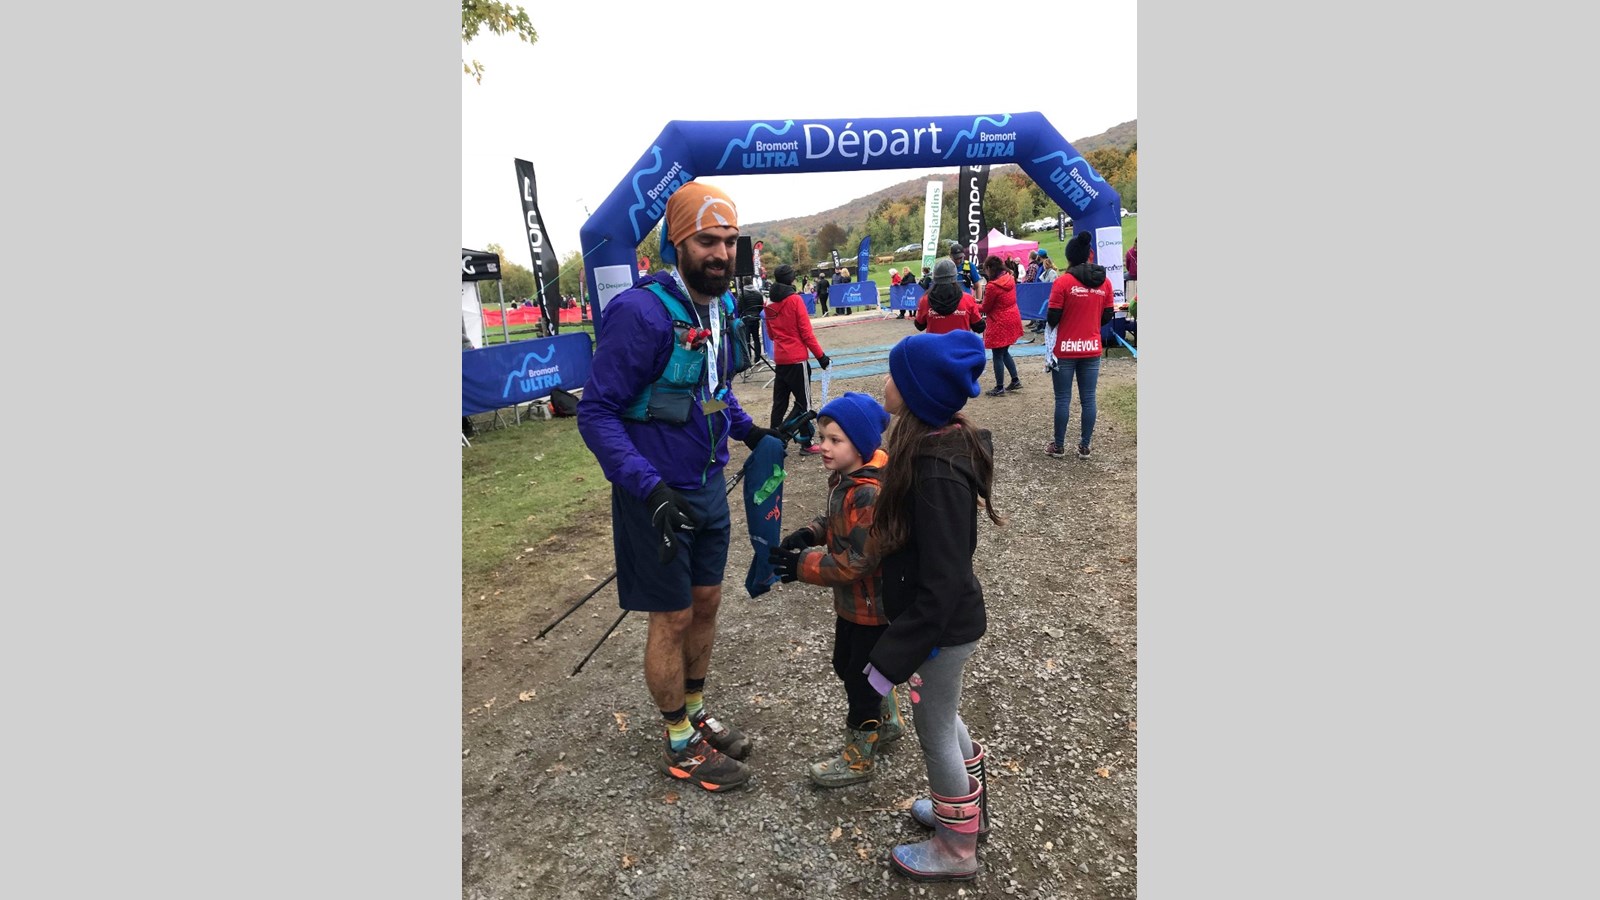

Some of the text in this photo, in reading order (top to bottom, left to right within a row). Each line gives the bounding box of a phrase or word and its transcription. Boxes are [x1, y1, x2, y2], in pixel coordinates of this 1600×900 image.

[755, 140, 799, 152] Bromont
[803, 121, 943, 166] Départ
[980, 131, 1017, 142] Bromont
[966, 141, 1015, 159] ULTRA
[742, 151, 800, 169] ULTRA
[647, 161, 682, 200] Bromont
[1049, 166, 1092, 212] ULTRA
[1069, 167, 1099, 199] Bromont
[926, 187, 940, 252] Desjardins
[1060, 338, 1099, 352] BÉNÉVOLE
[528, 364, 559, 378] Bromont
[520, 372, 562, 393] ULTRA
